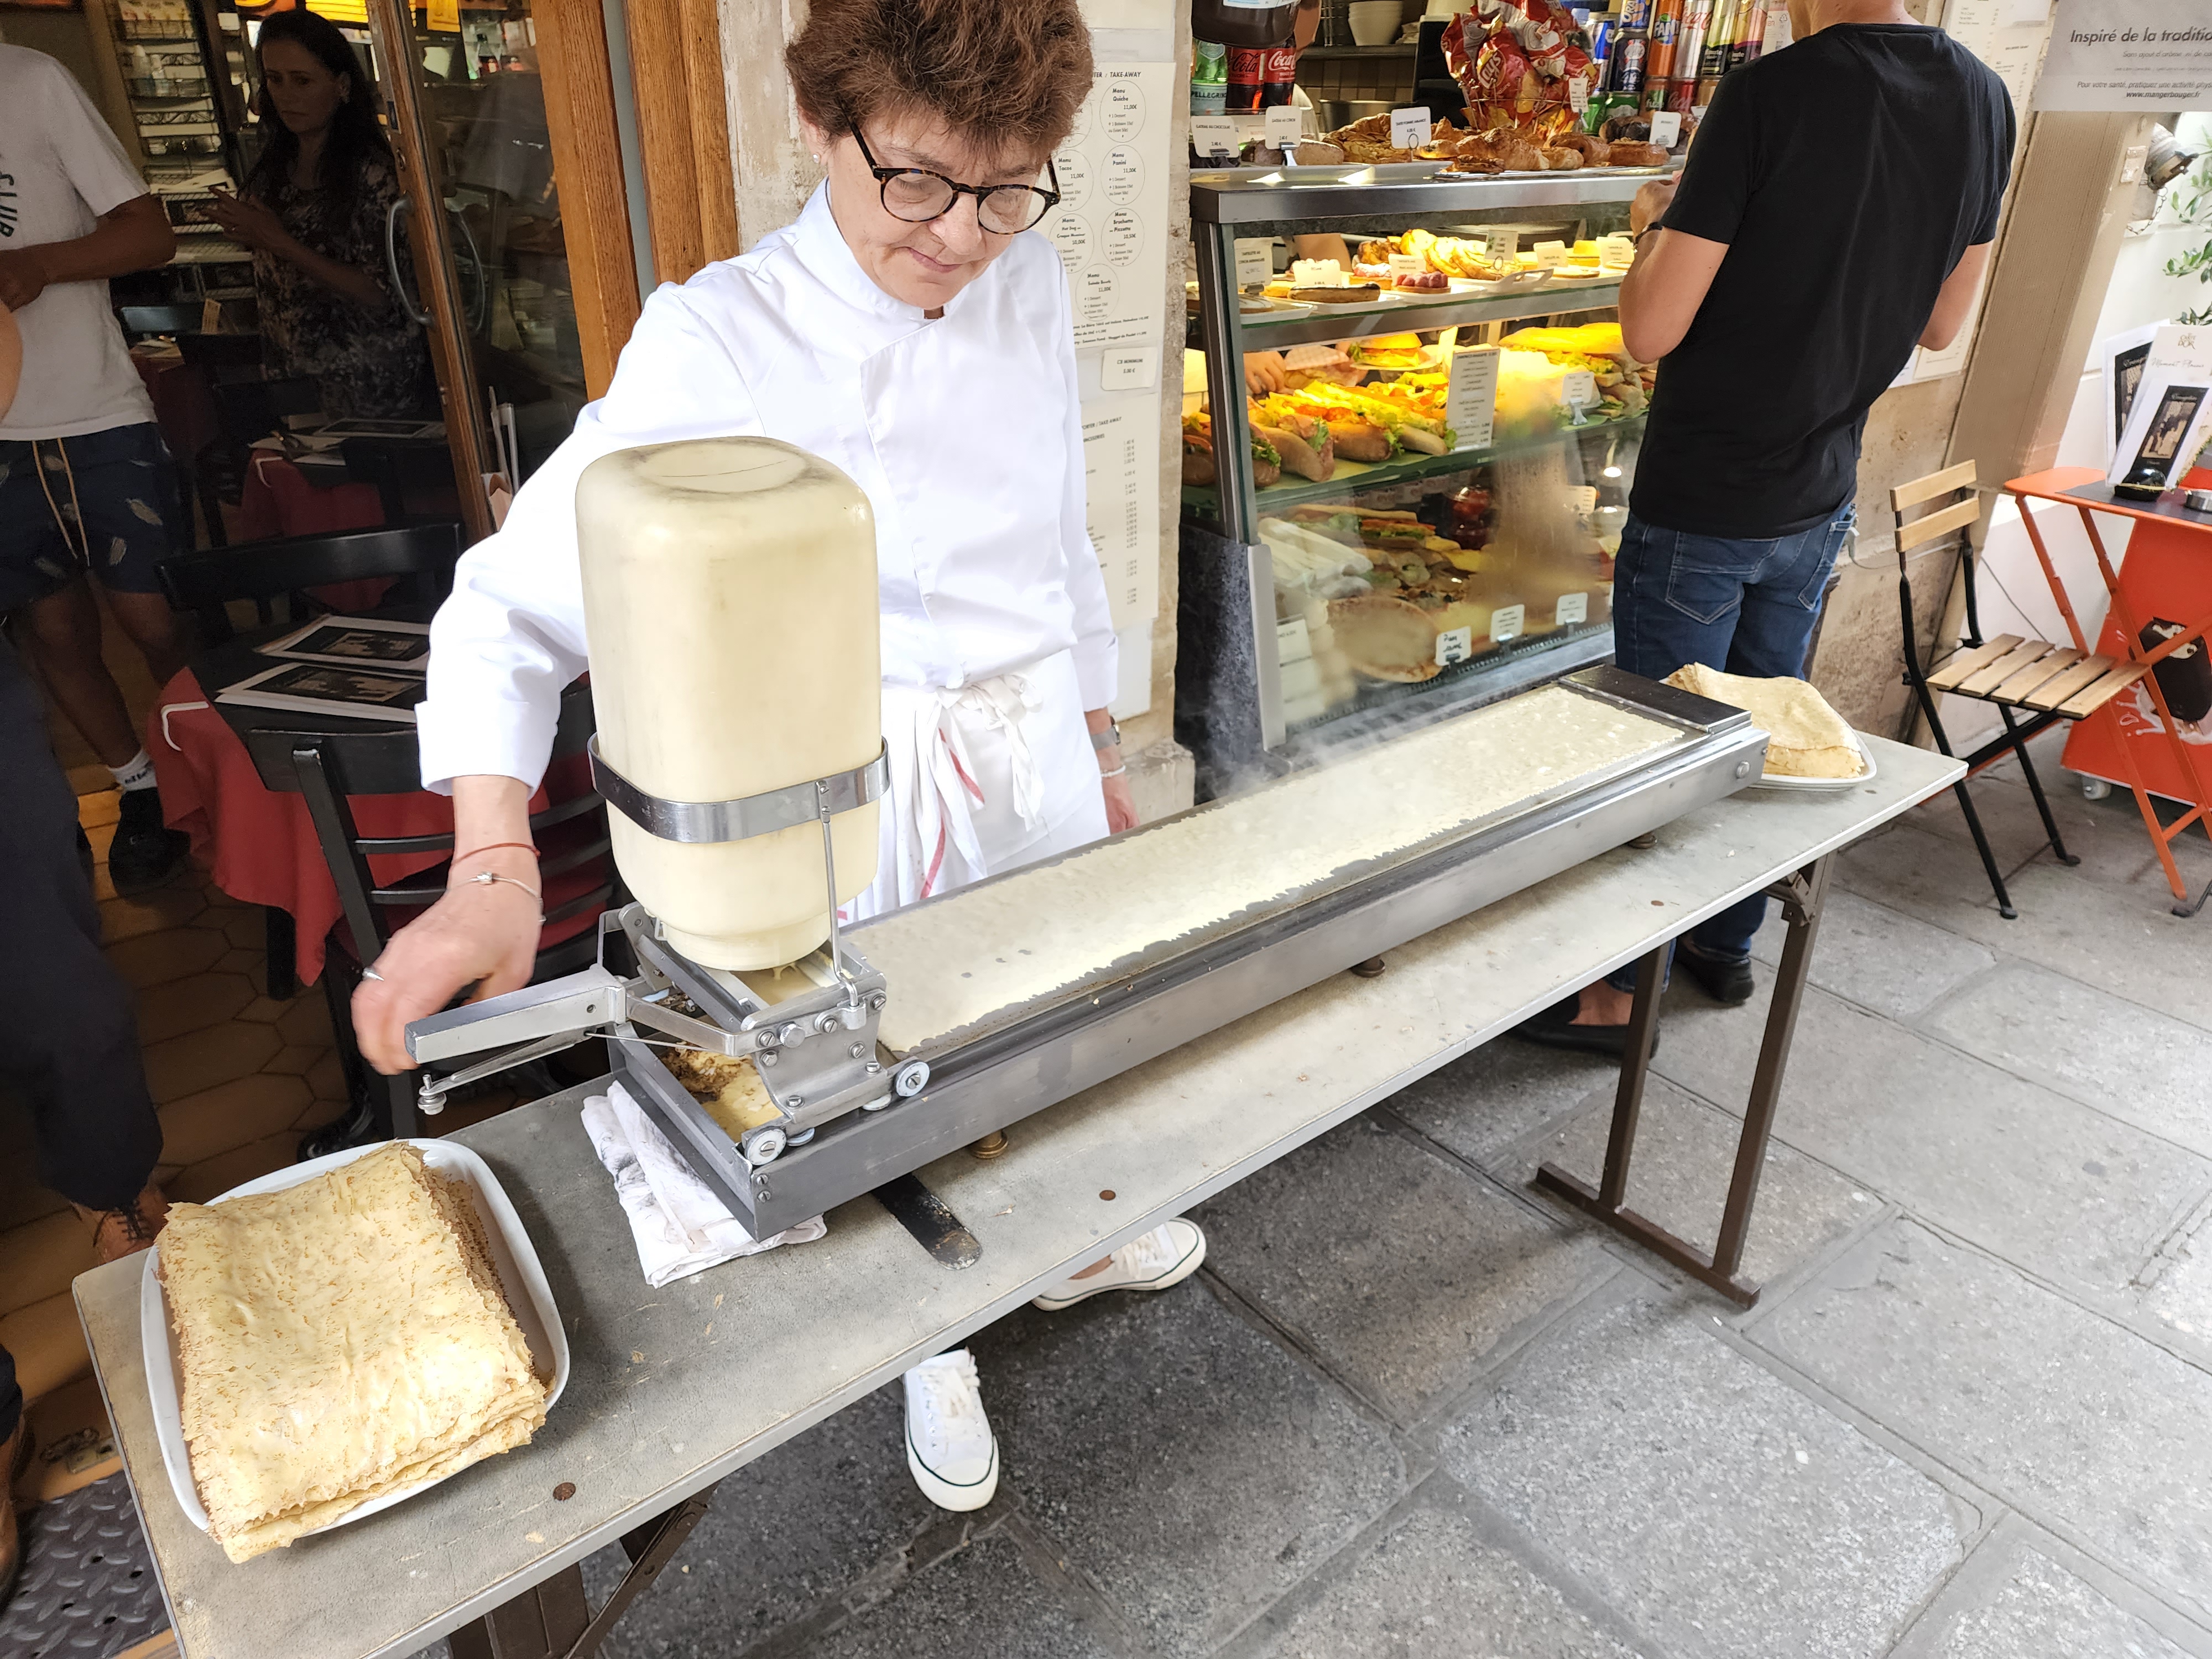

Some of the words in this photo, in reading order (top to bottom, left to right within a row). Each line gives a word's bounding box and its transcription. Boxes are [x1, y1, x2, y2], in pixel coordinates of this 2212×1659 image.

[2070, 29, 2117, 46] Inspiré
[2121, 28, 2139, 41] de
[2143, 27, 2158, 41] la
